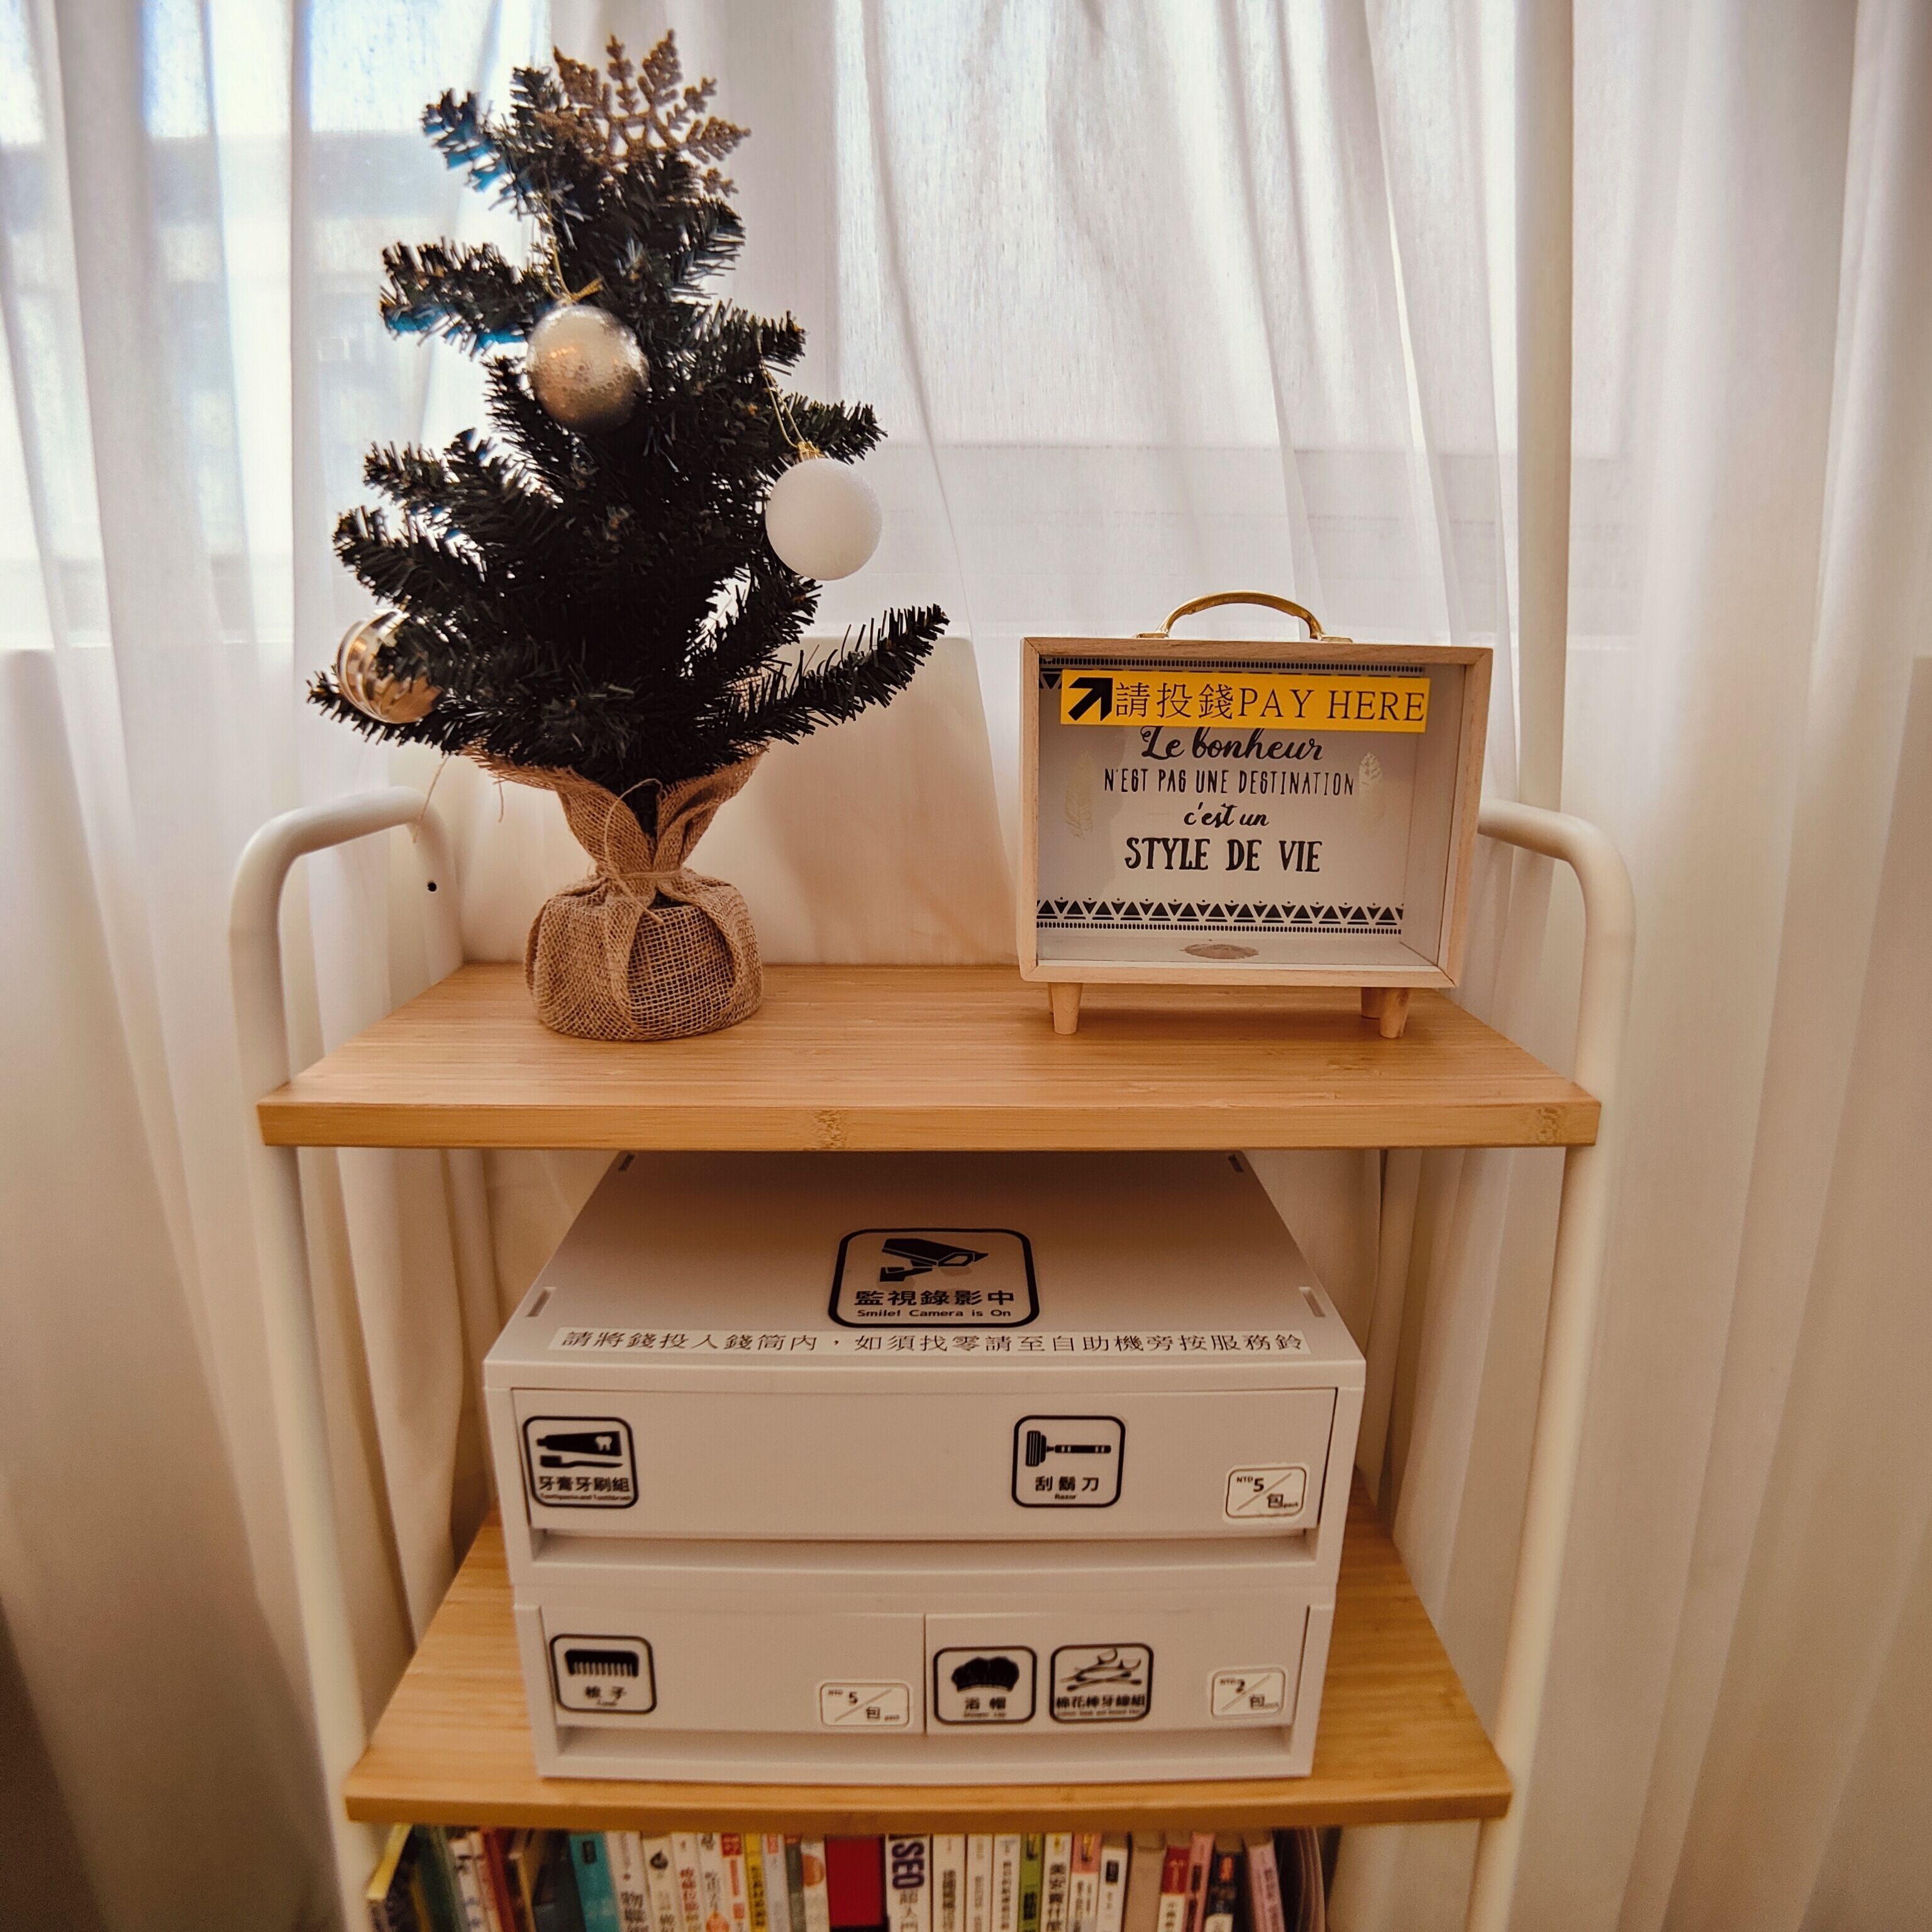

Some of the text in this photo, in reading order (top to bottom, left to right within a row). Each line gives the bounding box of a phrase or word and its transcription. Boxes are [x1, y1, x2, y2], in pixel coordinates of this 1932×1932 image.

[1326, 690, 1425, 721] HERE
[1140, 725, 1323, 760] Le bonheur
[1104, 768, 1354, 796] N'EST PAS UNE DESTINATION
[1184, 802, 1270, 828] c'est un
[1124, 837, 1323, 872] STYLE DE VIE
[853, 1289, 1014, 1306] 監視錄影中
[857, 1309, 1011, 1317] Smile! Camera is On
[538, 1475, 631, 1492] 牙膏牙刷組
[1253, 1477, 1264, 1492] 5
[848, 1690, 858, 1705] 5
[892, 1841, 924, 1890] SEO
